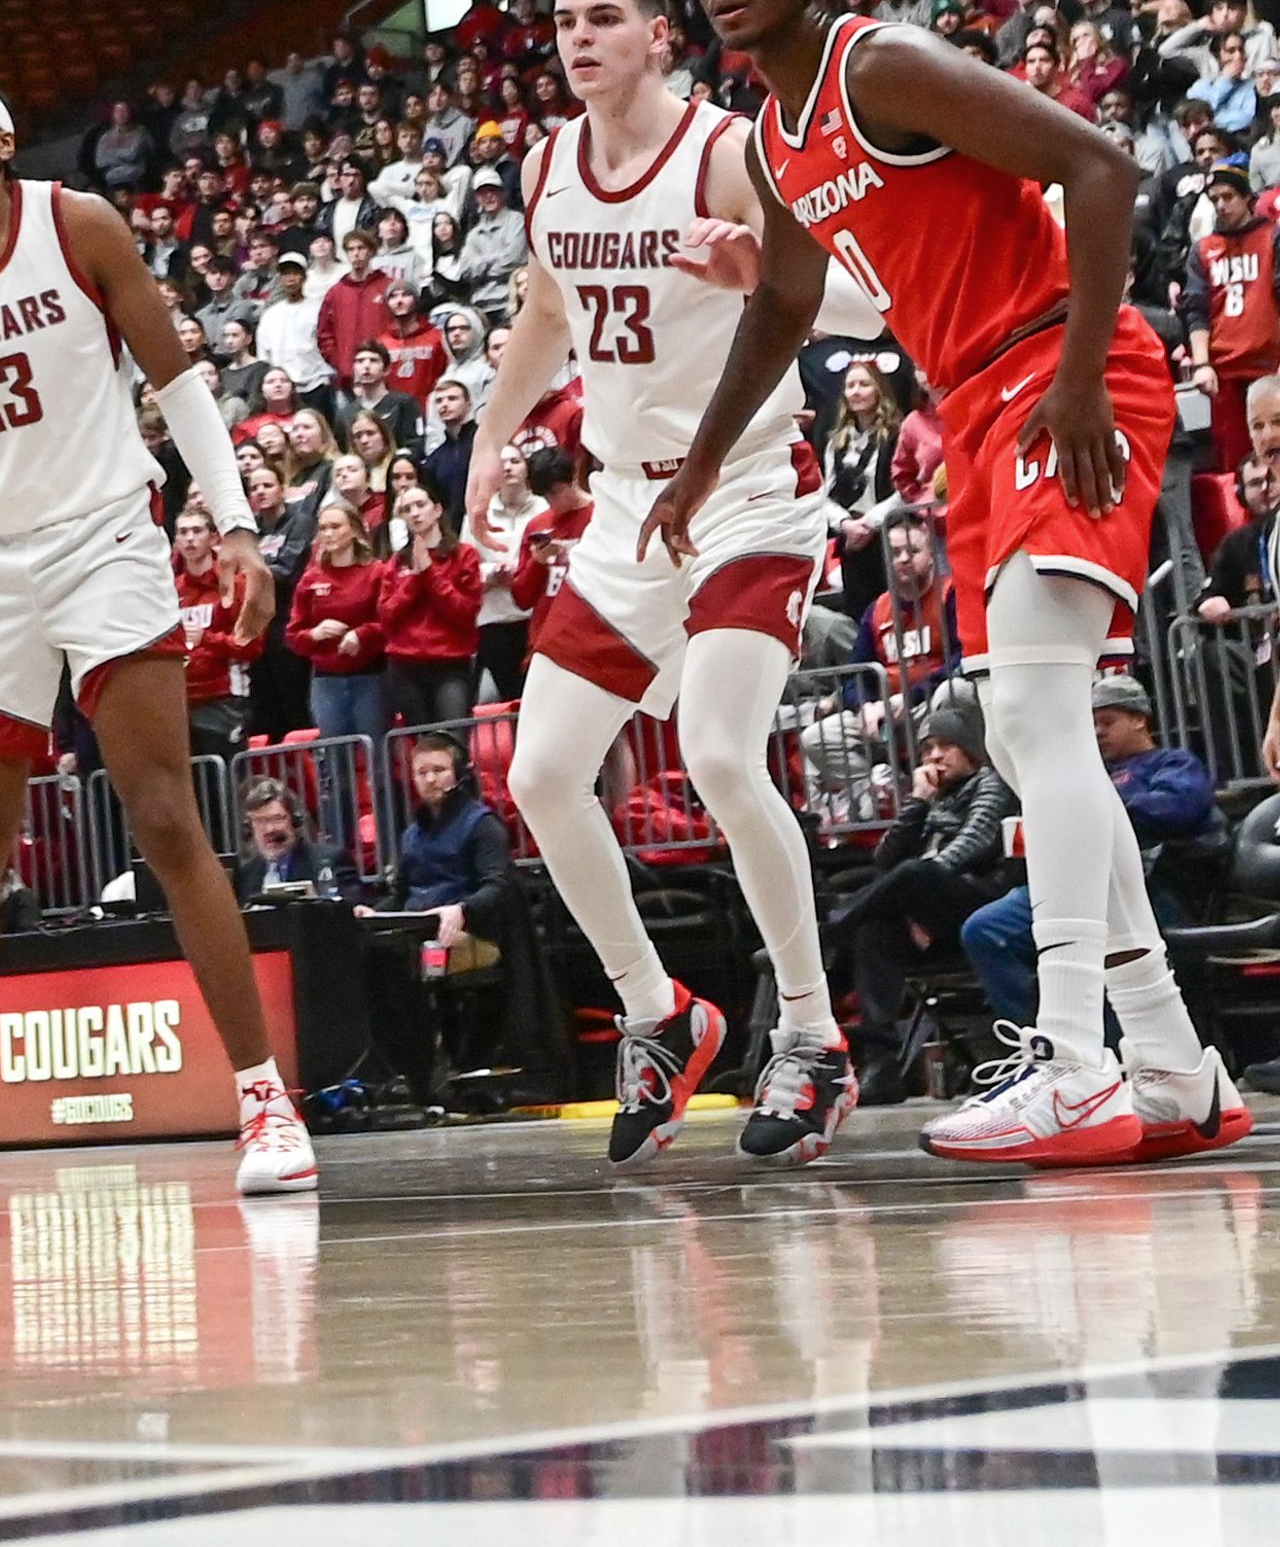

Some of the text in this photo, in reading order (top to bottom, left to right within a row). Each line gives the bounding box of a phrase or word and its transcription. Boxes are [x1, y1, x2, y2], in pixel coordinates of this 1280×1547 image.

[791, 160, 884, 228] ARIZONA
[547, 229, 680, 270] COUGARS
[833, 228, 892, 313] 0
[1209, 253, 1259, 287] WSU
[575, 284, 656, 365] 23
[650, 458, 679, 473] WSU
